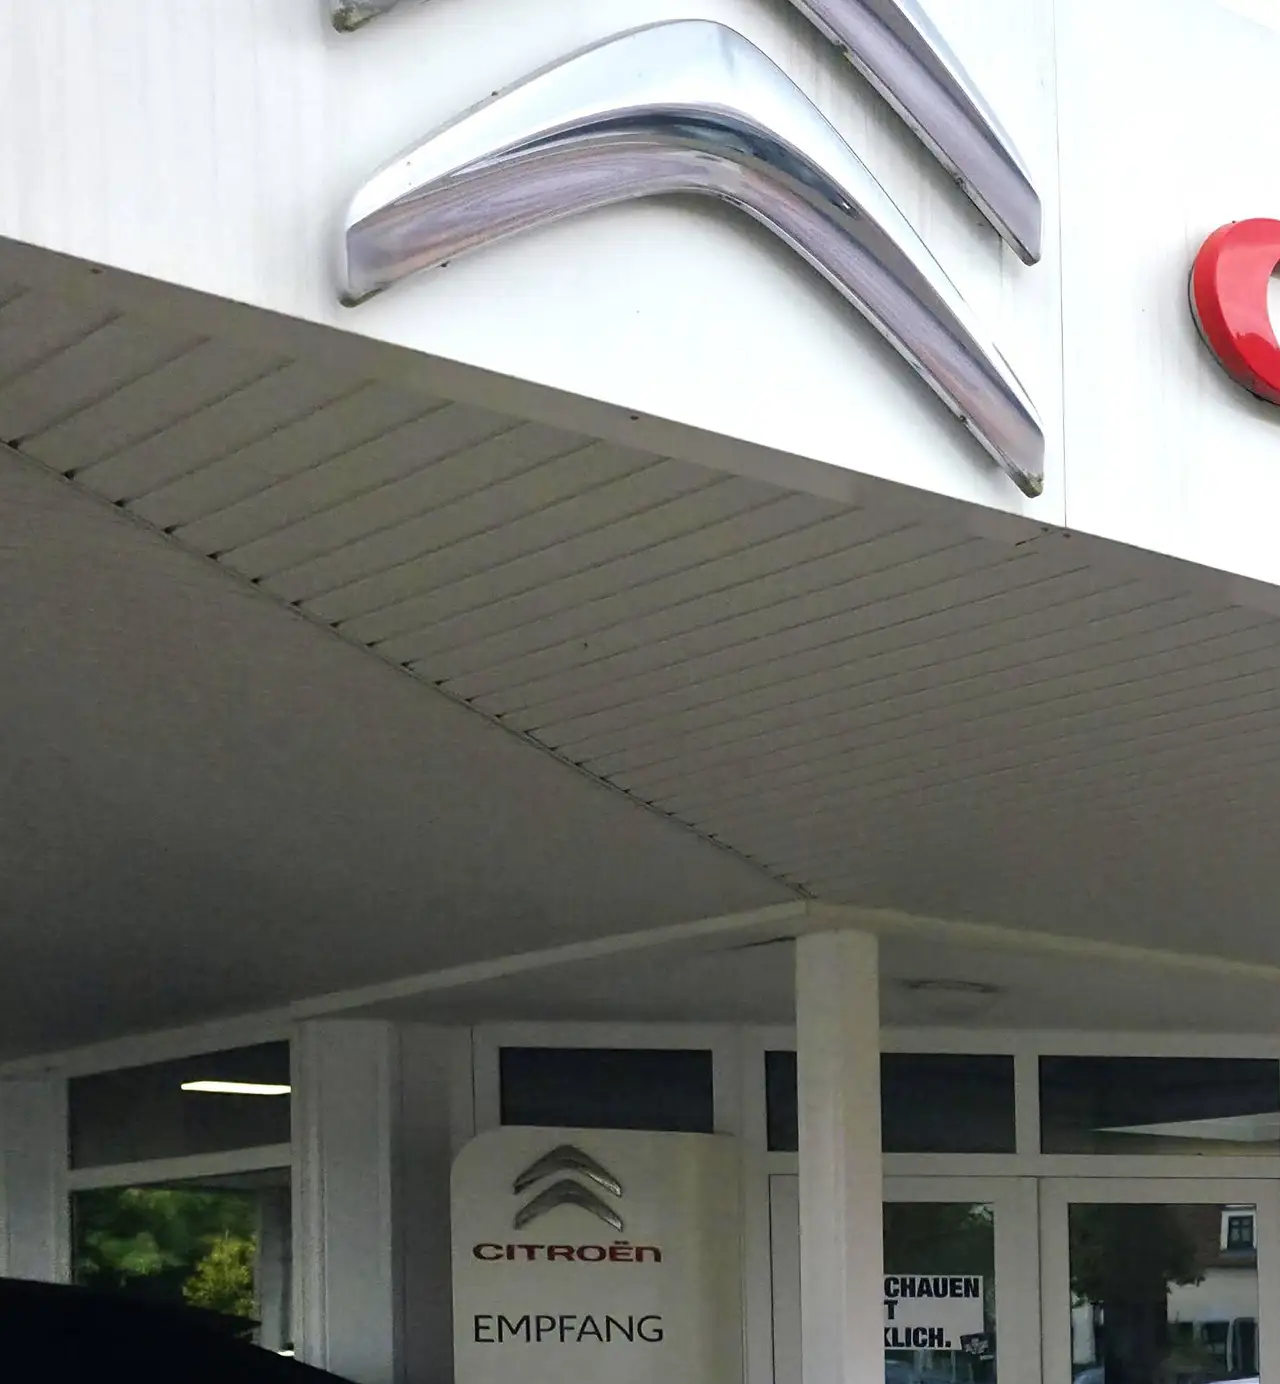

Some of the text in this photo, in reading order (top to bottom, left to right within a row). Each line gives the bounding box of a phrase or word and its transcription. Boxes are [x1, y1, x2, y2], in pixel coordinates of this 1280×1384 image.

[473, 1240, 662, 1262] CITROËN
[884, 1276, 980, 1299] CHAUEN
[884, 1299, 899, 1320] T
[473, 1314, 664, 1343] EMPFANG
